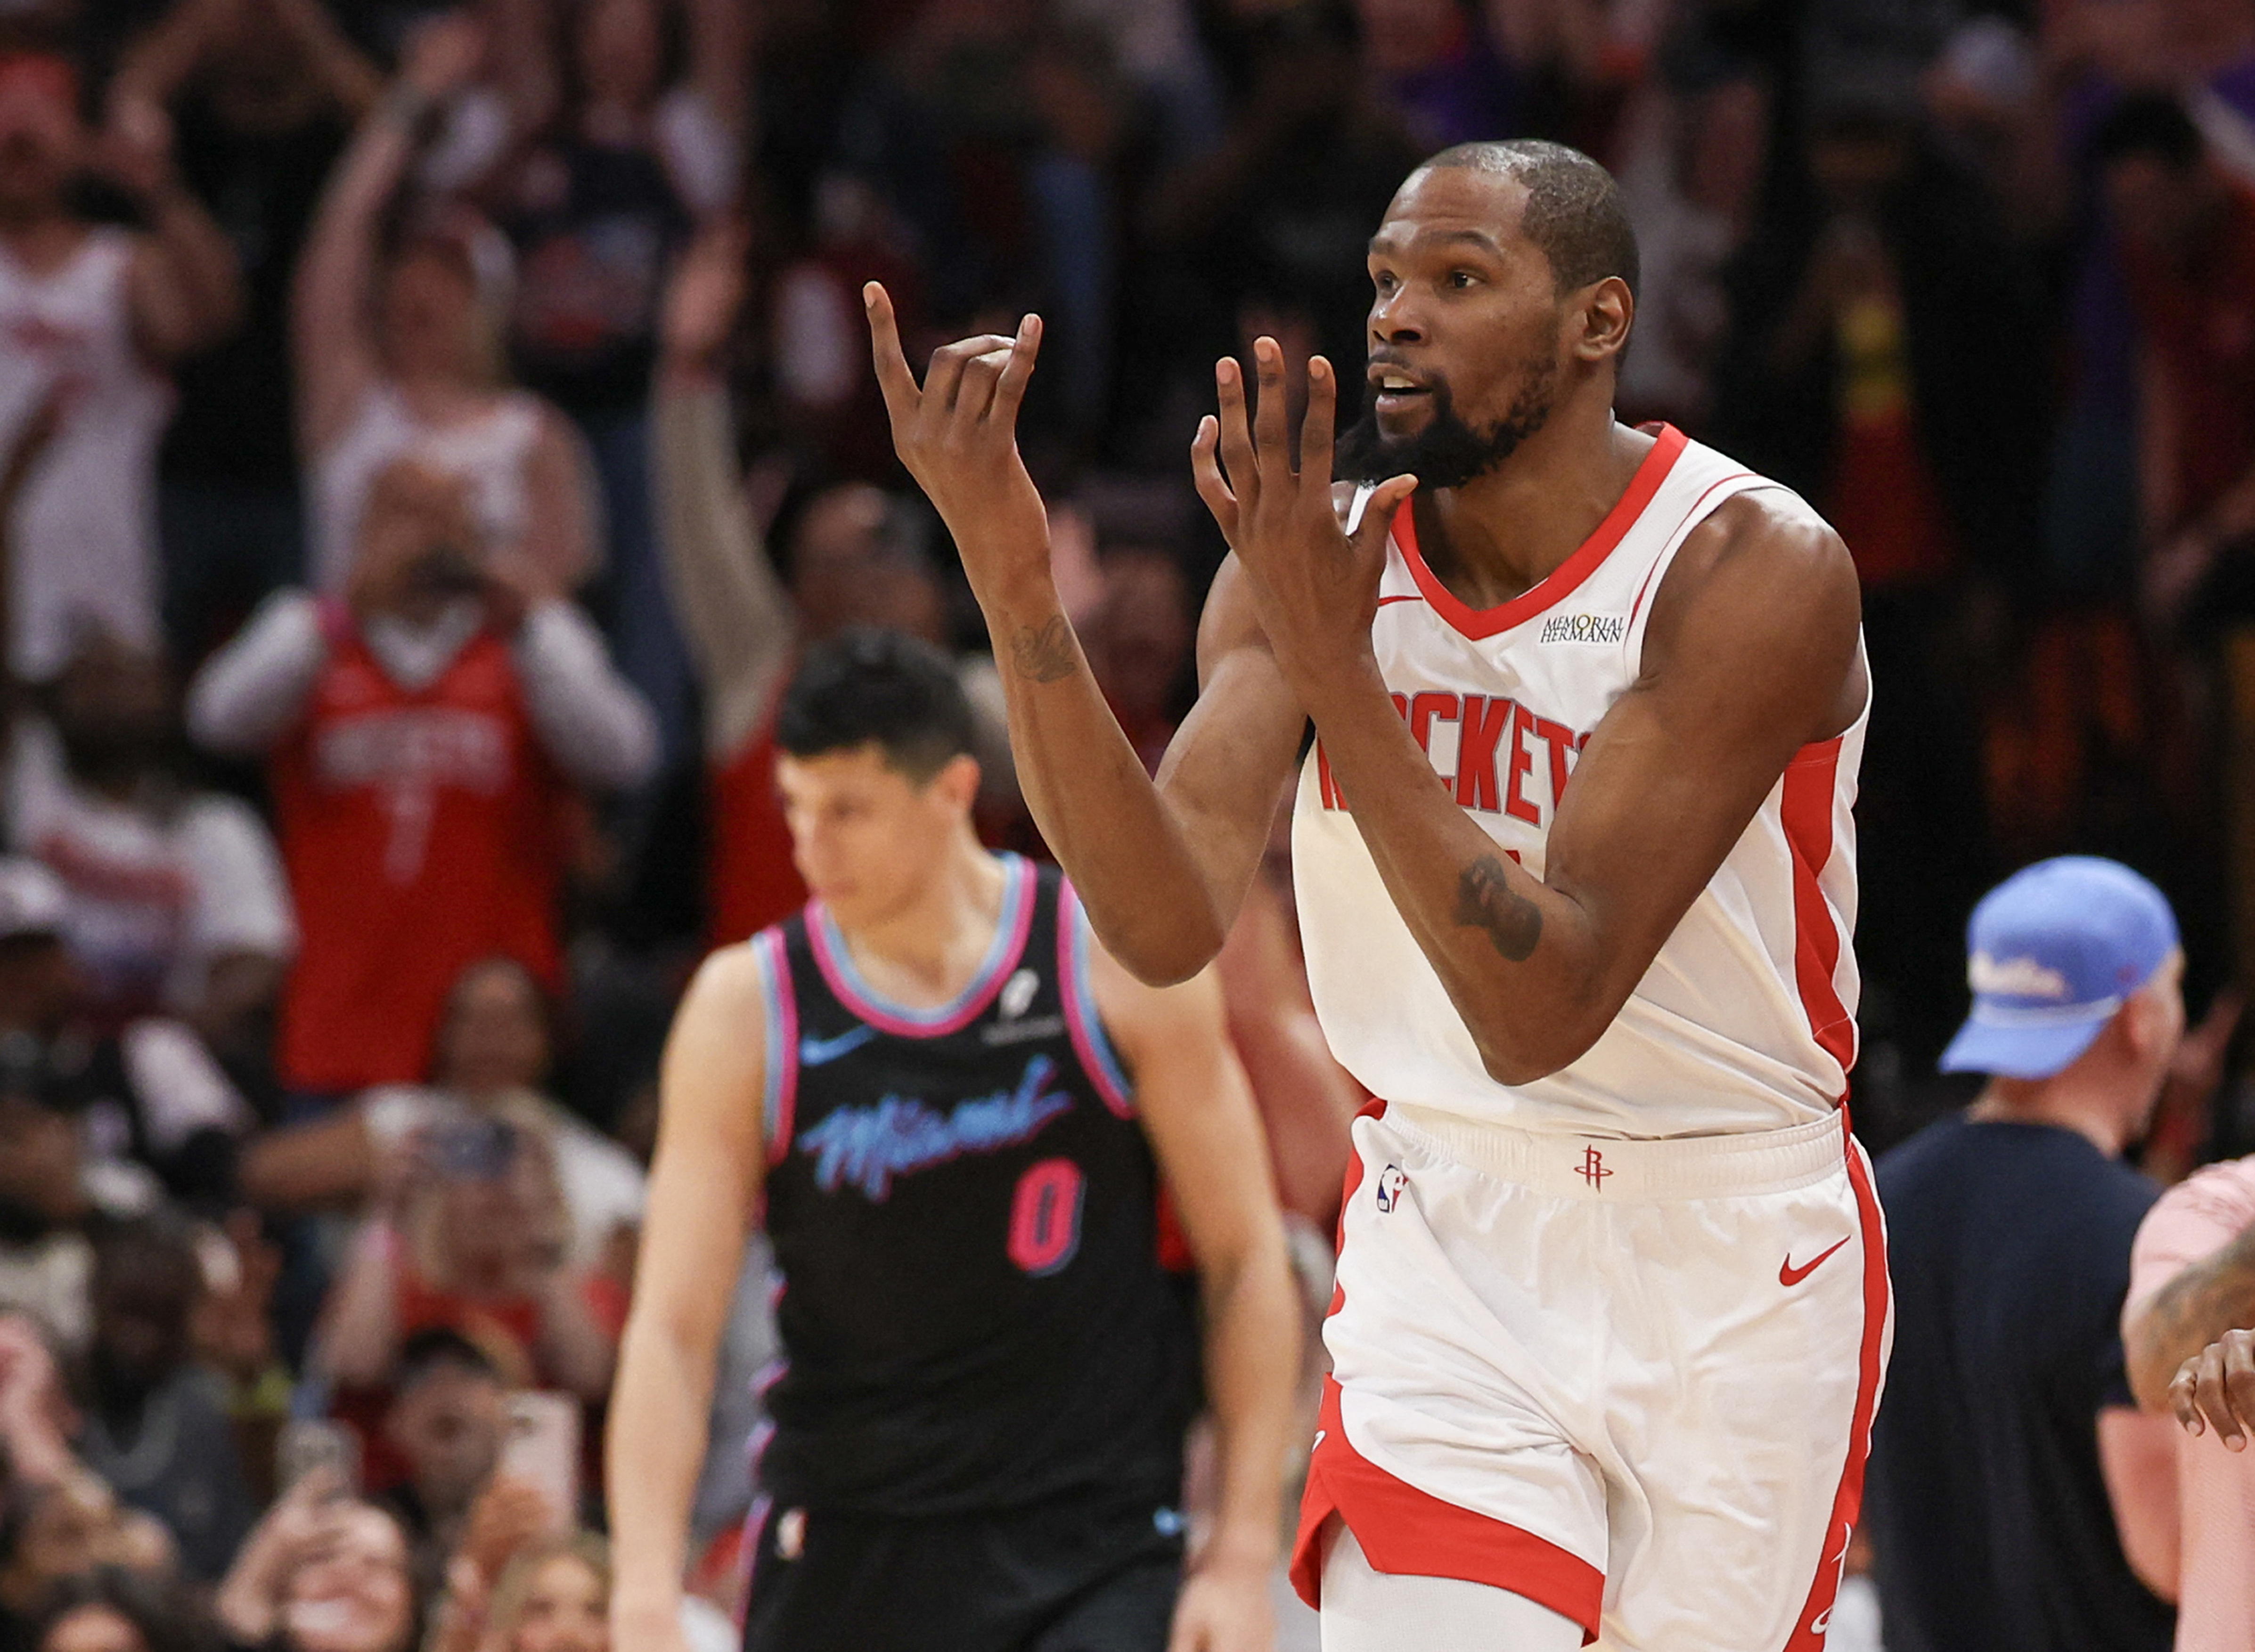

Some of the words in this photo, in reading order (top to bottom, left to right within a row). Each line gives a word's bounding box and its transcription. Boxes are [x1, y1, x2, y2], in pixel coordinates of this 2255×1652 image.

[1540, 627, 1622, 643] HERMANN
[1544, 615, 1624, 630] MEMORIAL
[1317, 691, 1591, 829] CKET
[1007, 1156, 1086, 1277] 0
